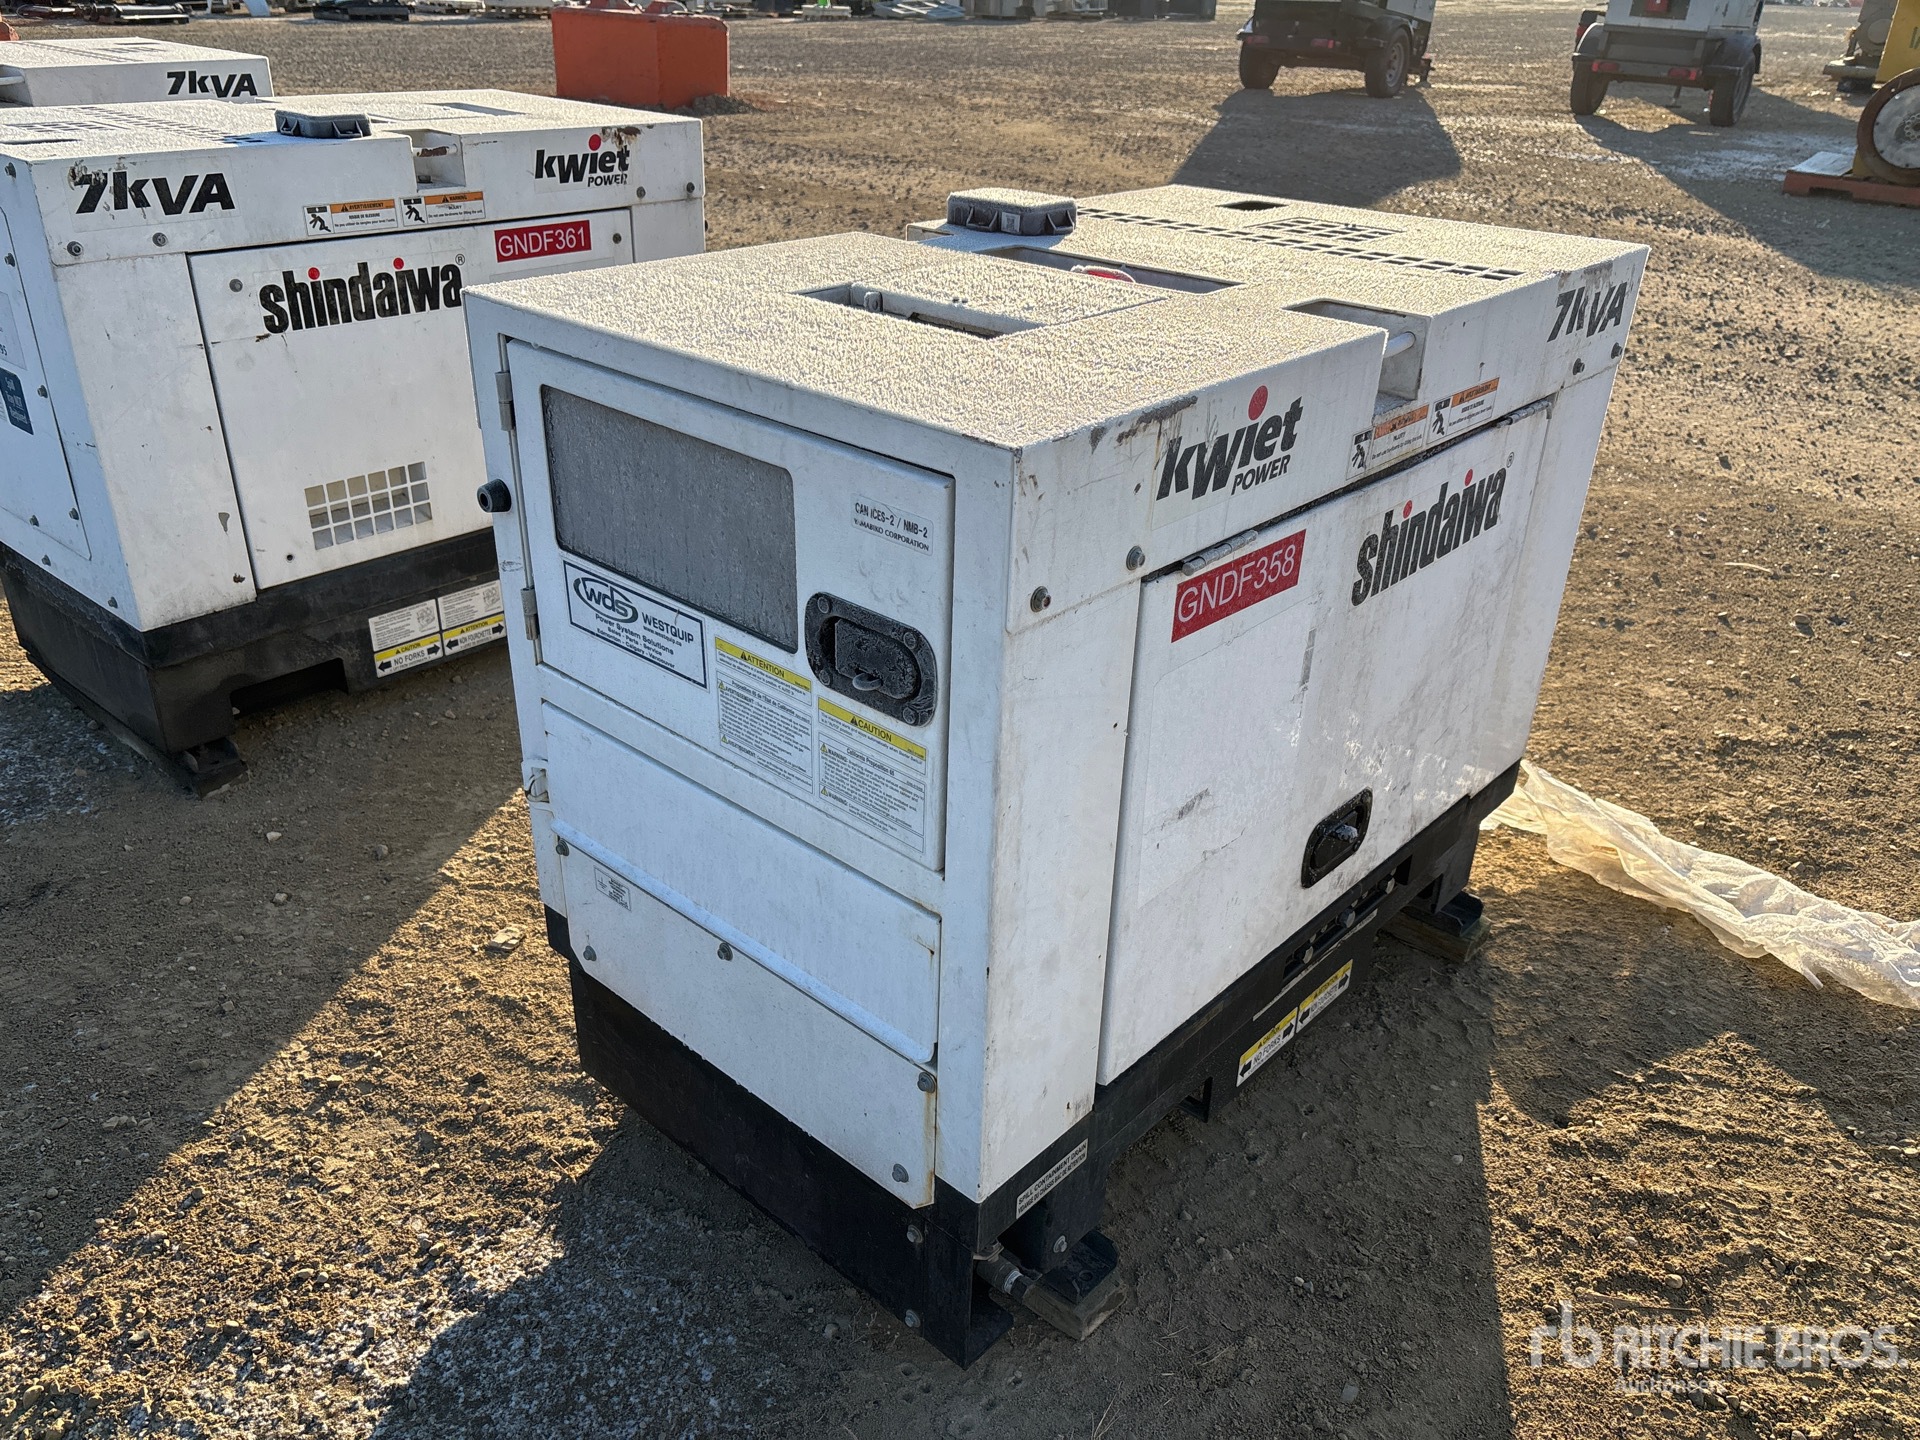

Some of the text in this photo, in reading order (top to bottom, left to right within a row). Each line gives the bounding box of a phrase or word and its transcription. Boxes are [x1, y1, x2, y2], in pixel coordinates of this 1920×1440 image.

[166, 70, 258, 98] 7kVA
[535, 134, 630, 184] kwiet
[73, 171, 235, 216] 7kVA
[587, 174, 628, 187] POWER
[498, 226, 585, 257] GNDF361
[1156, 385, 1303, 501] kwiet
[1231, 454, 1291, 495] POWER
[855, 502, 869, 517] CAN
[871, 508, 895, 526] ICES-2
[903, 519, 928, 538] NMB-2
[885, 529, 930, 551] CORPORATION
[582, 578, 629, 617] wds
[1177, 543, 1296, 622] GNDF358
[595, 613, 674, 656] Power System Solutions
[641, 611, 695, 644] WESTQUIP
[393, 649, 425, 665] NO FORKS
[644, 642, 662, 657] Service
[748, 654, 785, 678] ATTENTION
[857, 719, 892, 742] CAUTION
[1018, 1141, 1086, 1206] SPILL CONTAINMENT DRAIN
